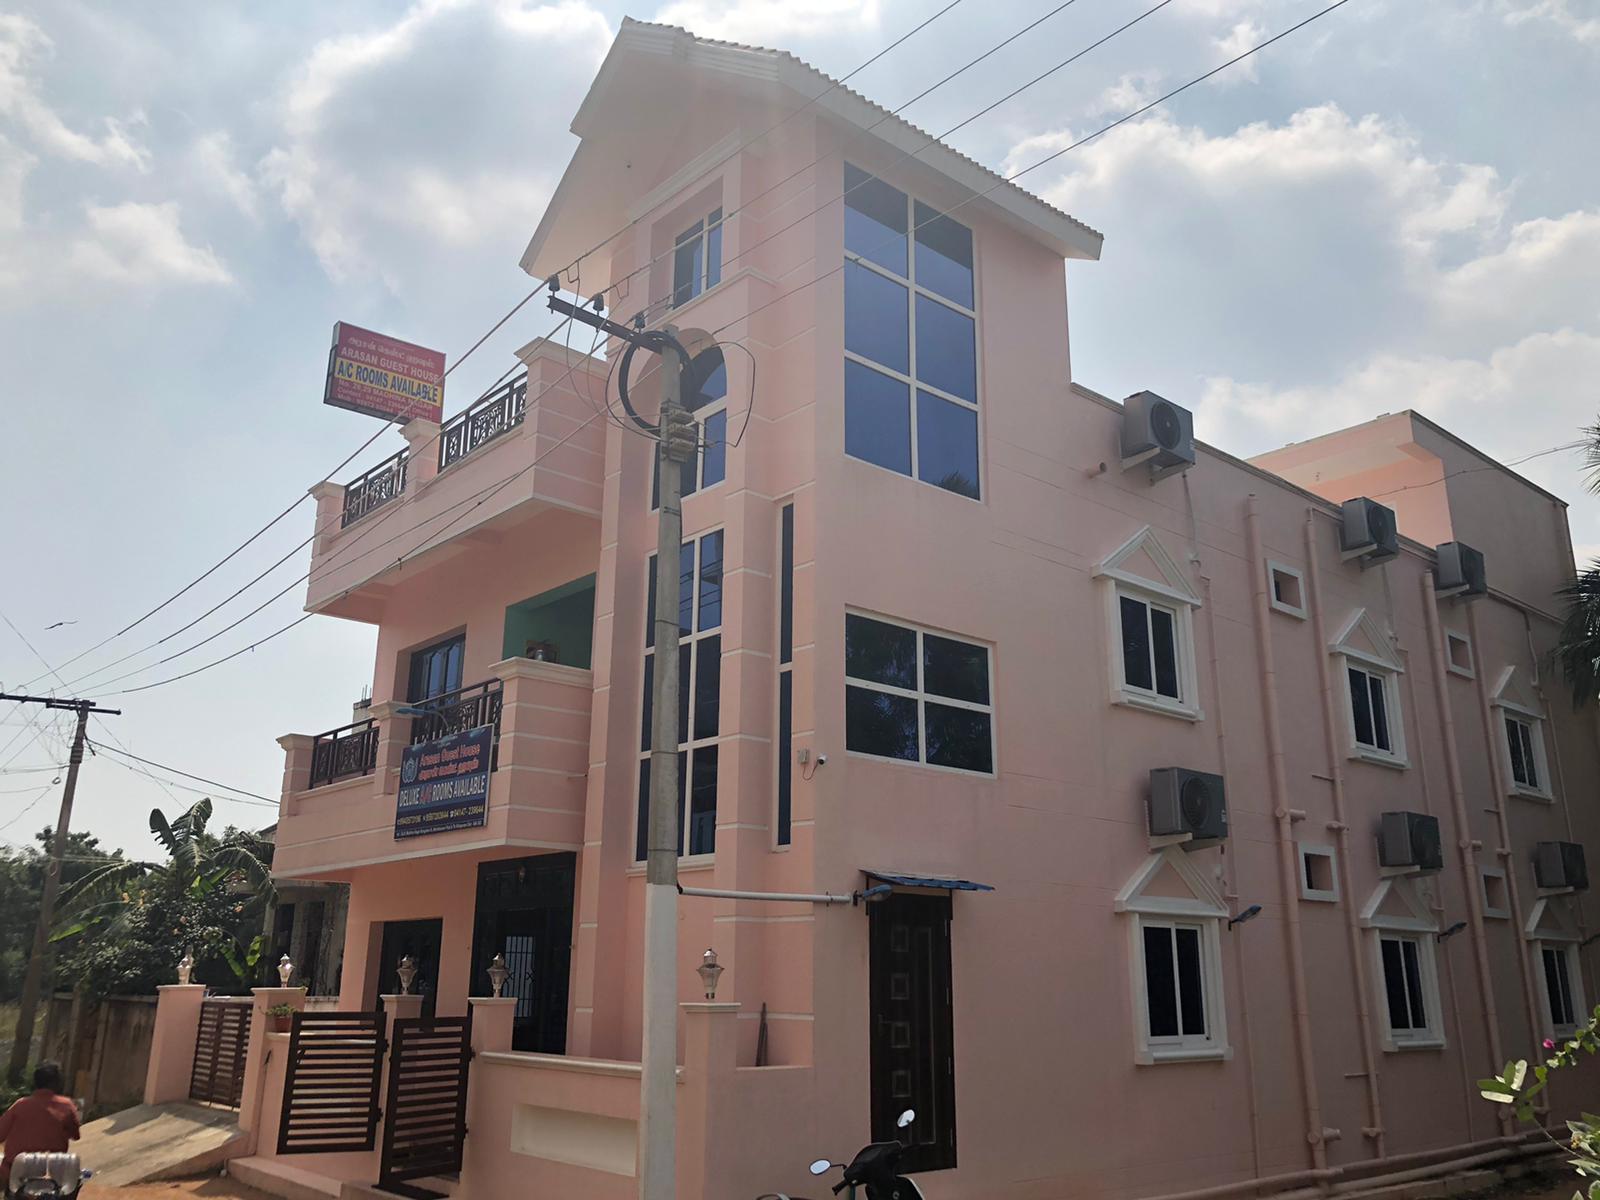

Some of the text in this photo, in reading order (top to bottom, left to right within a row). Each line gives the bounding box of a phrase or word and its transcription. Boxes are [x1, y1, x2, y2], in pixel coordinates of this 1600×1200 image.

[338, 361, 437, 402] A/C ROOMS AVAILABLE
[342, 347, 439, 382] ARASAN GUEST HOUSE
[399, 788, 419, 807] DELUXE
[432, 782, 453, 801] ROOMS
[453, 775, 485, 797] AVAILABLE
